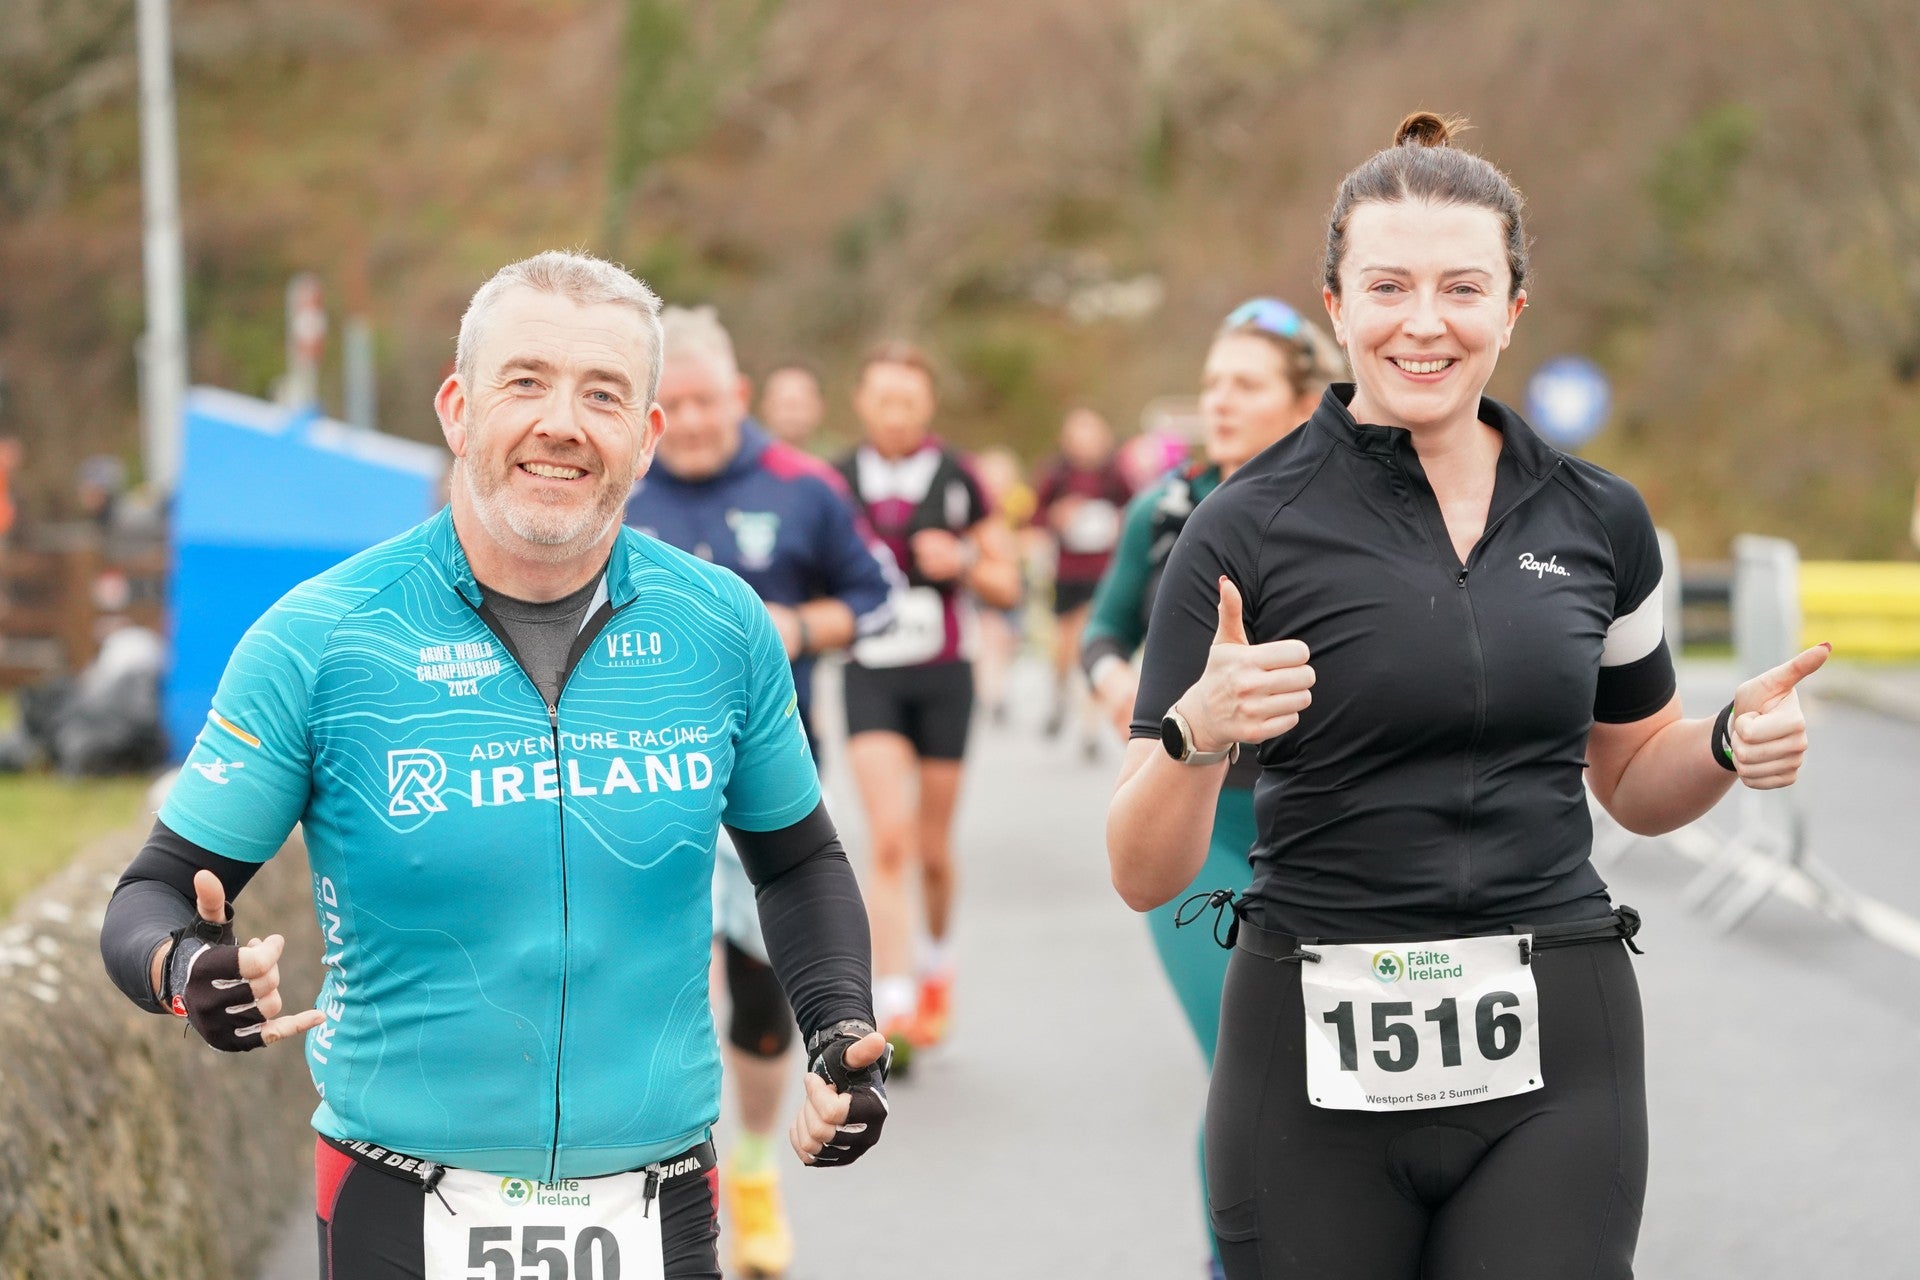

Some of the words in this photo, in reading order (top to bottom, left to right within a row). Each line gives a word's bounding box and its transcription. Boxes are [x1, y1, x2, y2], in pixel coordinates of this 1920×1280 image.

[1519, 552, 1571, 579] Rapha.
[420, 645, 452, 663] ARWS
[454, 642, 493, 661] WORLD
[607, 632, 662, 658] VELO
[416, 660, 500, 682] CHAMPIONSHIP
[448, 680, 478, 697] 2023
[469, 731, 618, 761] ADVENTURE
[629, 726, 708, 748] RACING
[470, 752, 713, 807] IRELAND
[1407, 950, 1450, 966] Fáilte
[1408, 964, 1463, 981] Ireland
[1322, 991, 1522, 1072] 1516
[1365, 1093, 1414, 1106] Westport
[1416, 1091, 1437, 1102] Sea
[1439, 1091, 1446, 1100] 2
[1449, 1085, 1488, 1099] Summit
[537, 1192, 590, 1206] Ireland
[466, 1225, 621, 1280] 550
